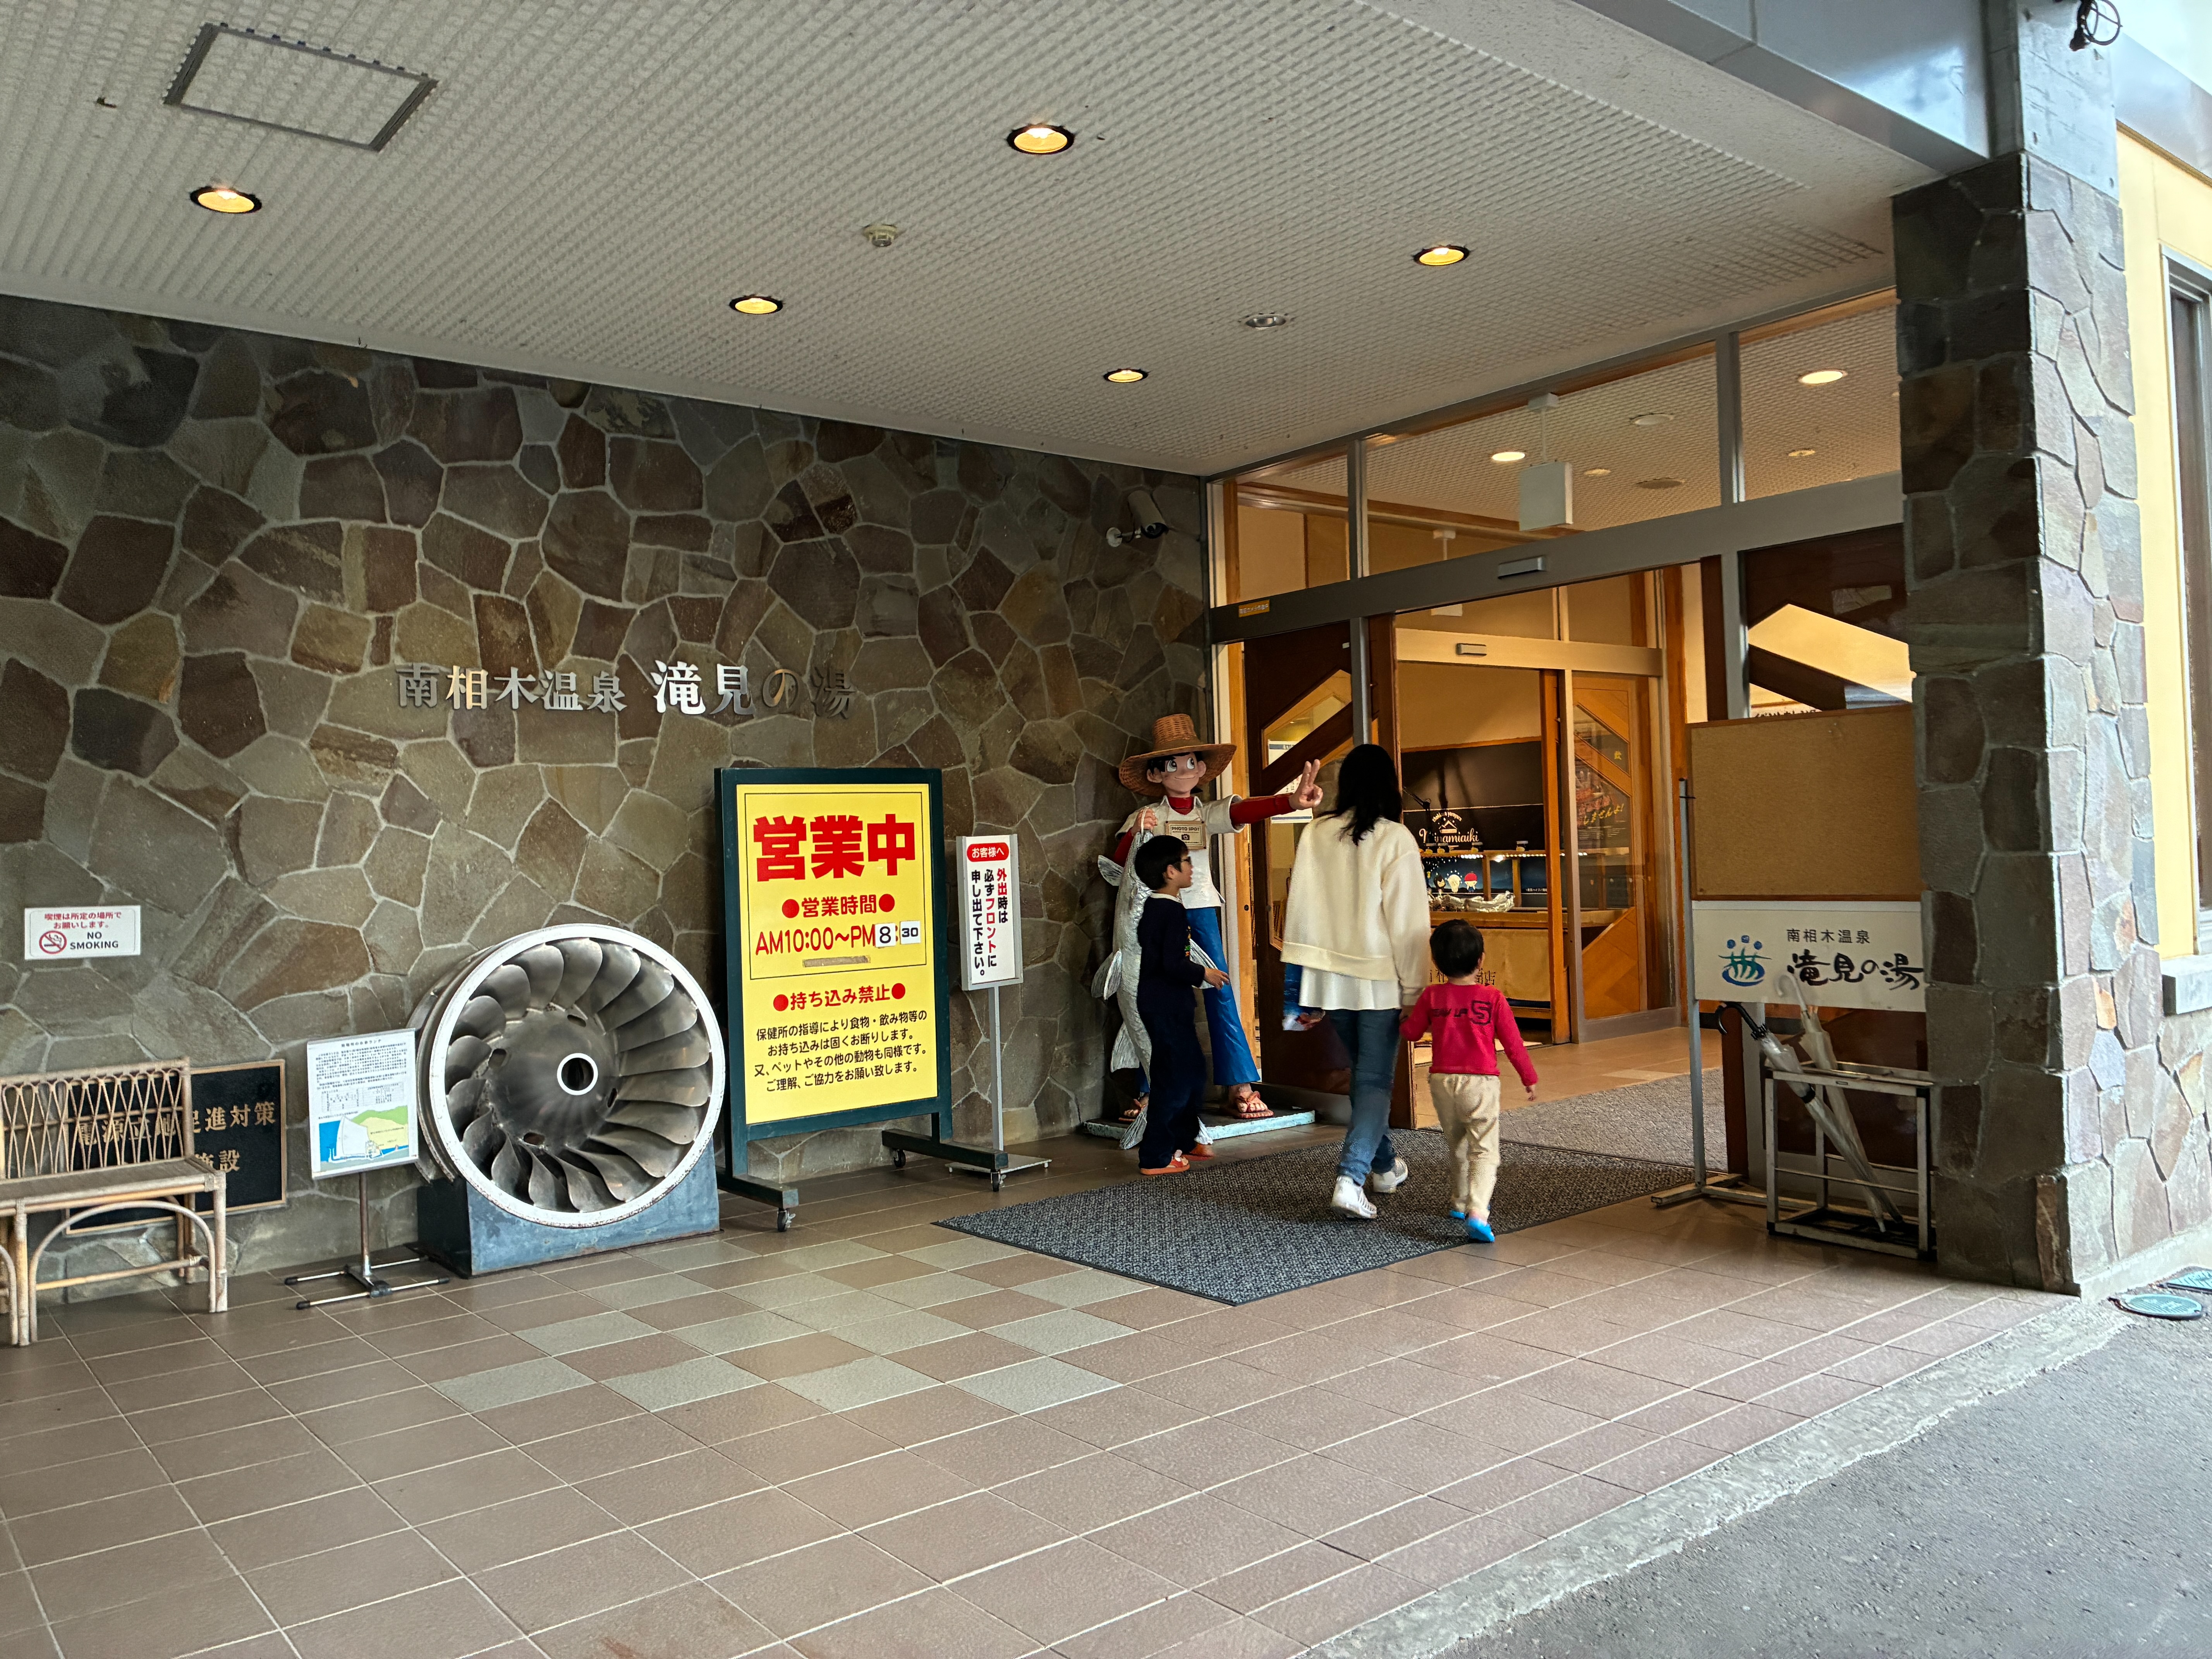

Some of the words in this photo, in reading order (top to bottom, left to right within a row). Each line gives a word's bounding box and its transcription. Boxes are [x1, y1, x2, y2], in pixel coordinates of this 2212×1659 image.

[396, 663, 628, 713] 南相木温泉
[651, 659, 857, 720] 滝見の湯
[753, 814, 915, 882] 営業中
[972, 847, 1004, 858] お客様へ
[802, 894, 877, 918] 営業時間
[997, 868, 1008, 924] 外出時は
[45, 912, 122, 921] 喫煙は所定の場所で
[53, 921, 109, 929] お願いします。
[971, 870, 985, 976] 申し出て下さい。
[984, 869, 997, 967] 必ずフロントに
[70, 941, 118, 950] SMOKING
[87, 931, 102, 939] NO
[1786, 928, 1870, 944] 南相木温泉
[1787, 949, 1923, 990] 滝見の湯
[790, 984, 890, 1010] 持ち込み禁止
[756, 1010, 927, 1041] 保健所の指導により食物・飲み物等の
[768, 1028, 914, 1057] お持ち込みは固くお断りします。
[754, 1043, 926, 1077] 又、ペットやその他の動物も同様です。
[766, 1061, 917, 1092] ご理解、ご協力をお願い致します。
